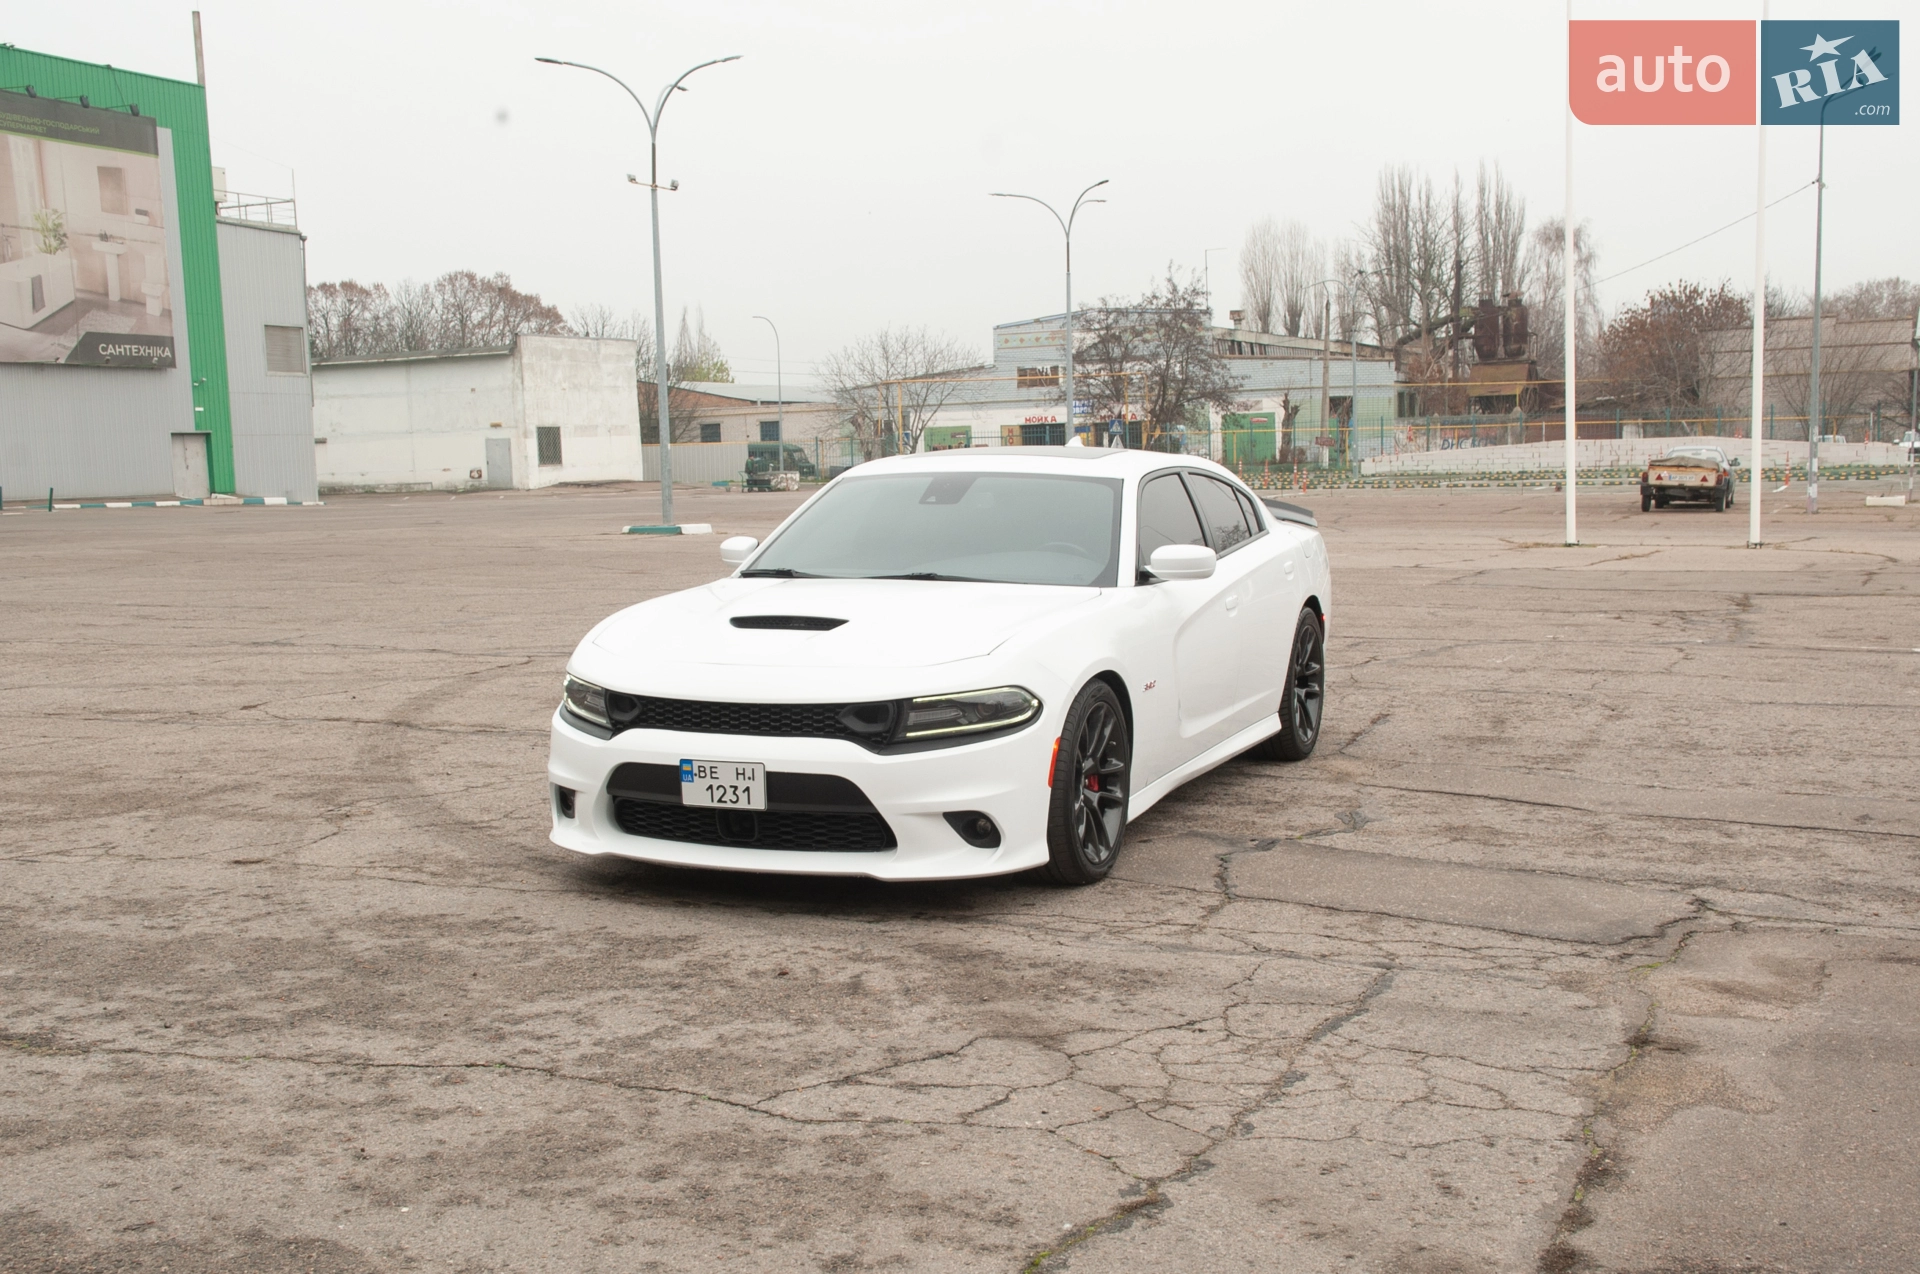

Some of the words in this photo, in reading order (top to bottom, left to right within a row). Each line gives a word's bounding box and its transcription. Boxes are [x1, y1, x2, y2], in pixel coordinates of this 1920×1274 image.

[98, 343, 172, 358] САНТЕХНІКА
[1024, 415, 1057, 424] МОЙКА
[682, 774, 693, 782] UA
[698, 765, 719, 780] BE
[705, 784, 751, 805] 1231
